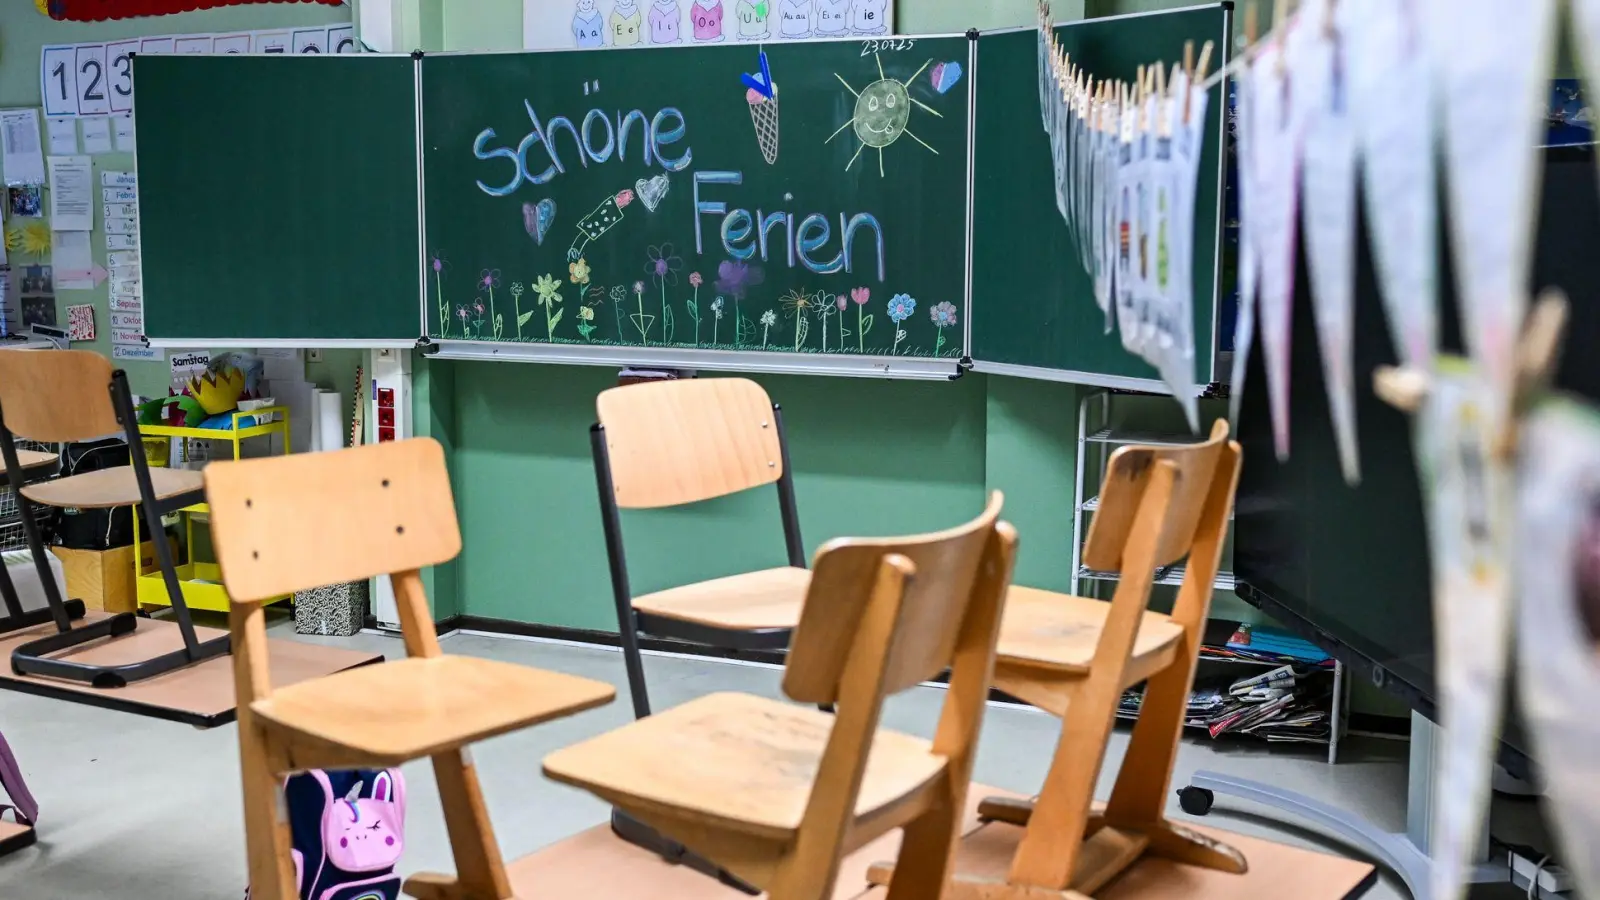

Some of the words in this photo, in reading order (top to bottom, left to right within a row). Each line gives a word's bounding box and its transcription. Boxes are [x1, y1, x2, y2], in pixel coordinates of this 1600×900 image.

[743, 13, 752, 24] U
[783, 10, 793, 20] Au
[795, 12, 806, 20] au
[822, 10, 830, 19] Ei
[863, 8, 875, 20] ie
[698, 16, 706, 28] O
[579, 29, 586, 39] A
[591, 30, 598, 38] a
[616, 24, 622, 35] E
[628, 26, 634, 34] e
[53, 60, 67, 100] 1
[81, 60, 104, 100] 2
[113, 55, 131, 96] 3
[473, 80, 693, 197] Schöne
[693, 171, 885, 283] Ferien
[172, 355, 209, 367] Samstag
